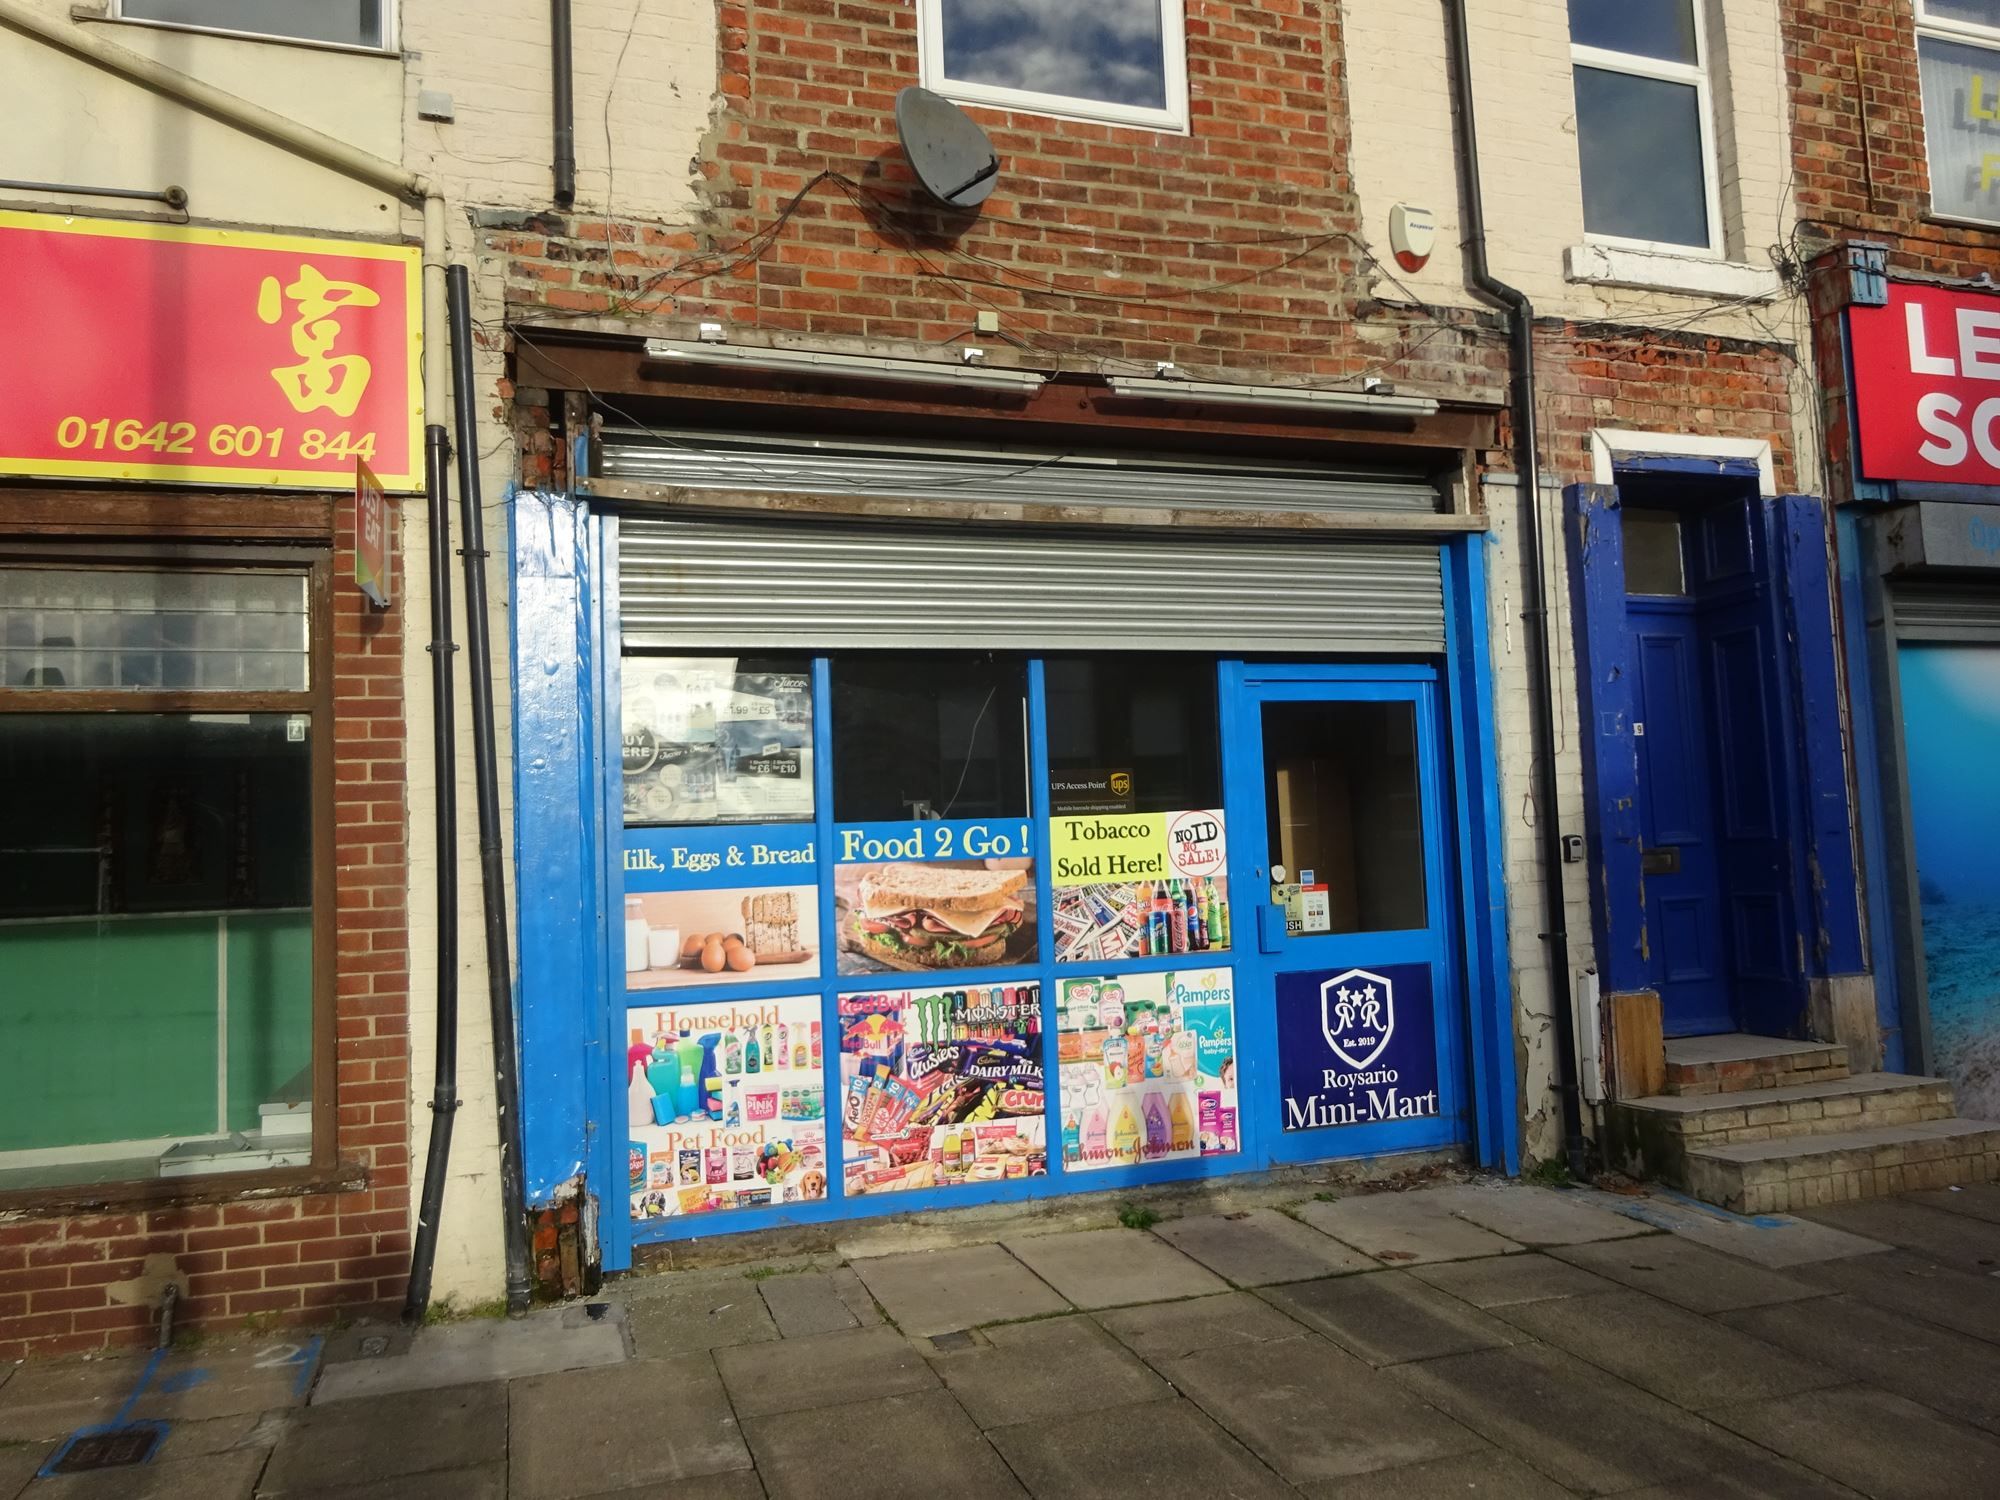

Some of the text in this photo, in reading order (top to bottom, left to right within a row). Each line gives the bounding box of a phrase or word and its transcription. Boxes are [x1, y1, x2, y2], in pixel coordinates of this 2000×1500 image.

[257, 263, 381, 418] 富
[57, 415, 377, 462] 01642 601 844
[361, 474, 381, 520] JUST
[365, 510, 381, 552] EAT
[757, 764, 770, 774] £6
[780, 764, 797, 774] £10
[1051, 781, 1106, 790] UPS Access Point
[1112, 780, 1128, 793] ups
[1065, 820, 1151, 841] Tobacco
[840, 827, 925, 861] Food
[934, 827, 953, 857] 2
[963, 825, 1011, 857] Go
[1183, 842, 1197, 852] NO
[671, 847, 720, 872] Eggs
[726, 845, 746, 866] &
[751, 842, 815, 866] Bread
[1057, 852, 1163, 878] Sold Here!
[1178, 848, 1220, 866] SALE!
[838, 991, 912, 1015] Red Bull
[1175, 984, 1231, 1005] Pampers
[656, 1005, 780, 1032] Household
[1199, 1035, 1233, 1049] Pampers
[1343, 1036, 1376, 1048] Est. 2019
[969, 1064, 1044, 1079] DAIRY MILK
[1322, 1064, 1399, 1090] Roysario
[747, 1100, 773, 1111] PINK
[1285, 1087, 1438, 1131] Mini-Mart
[667, 1125, 766, 1152] Pet Food
